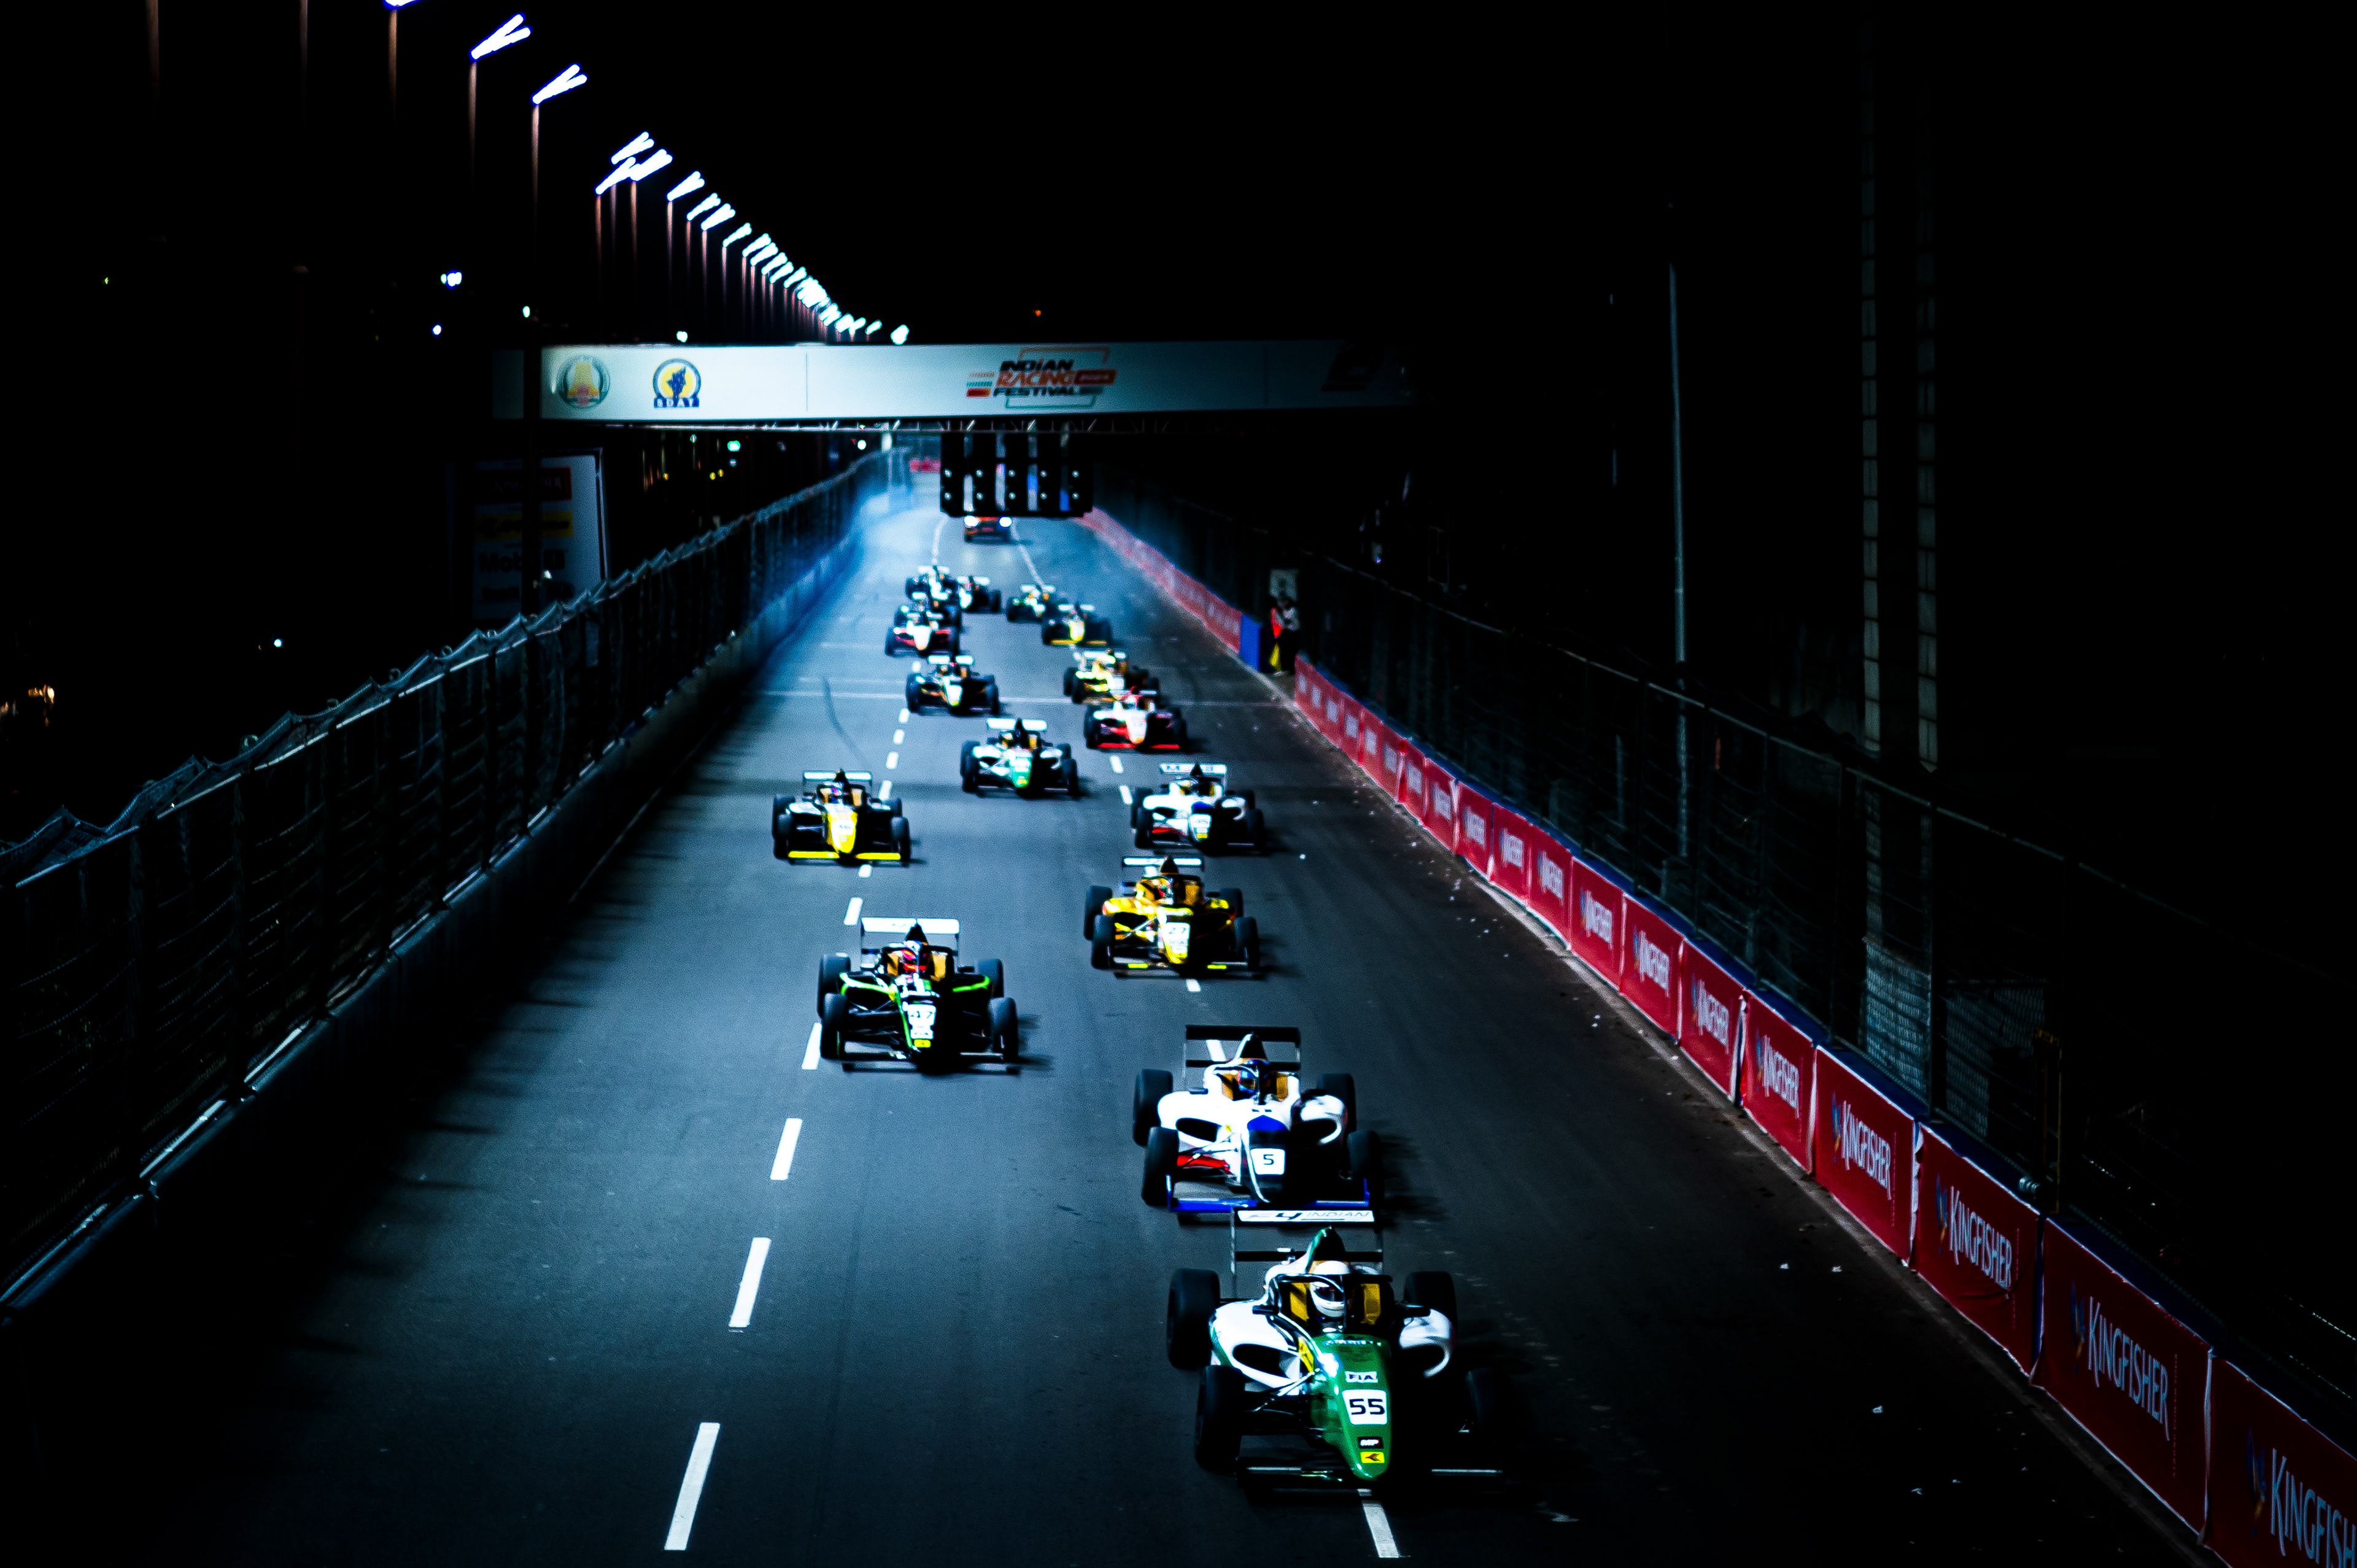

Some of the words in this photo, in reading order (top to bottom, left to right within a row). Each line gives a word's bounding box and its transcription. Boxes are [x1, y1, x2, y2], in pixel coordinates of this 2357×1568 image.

[996, 371, 1076, 387] RACING
[993, 387, 1081, 396] FESTIVAL
[1841, 1100, 1891, 1201] KINGFISHER
[1263, 1154, 1275, 1165] 5
[1949, 1186, 2013, 1300] KINGFISHER
[2088, 1296, 2170, 1442] KINGFISHER
[1349, 1398, 1386, 1415] 55
